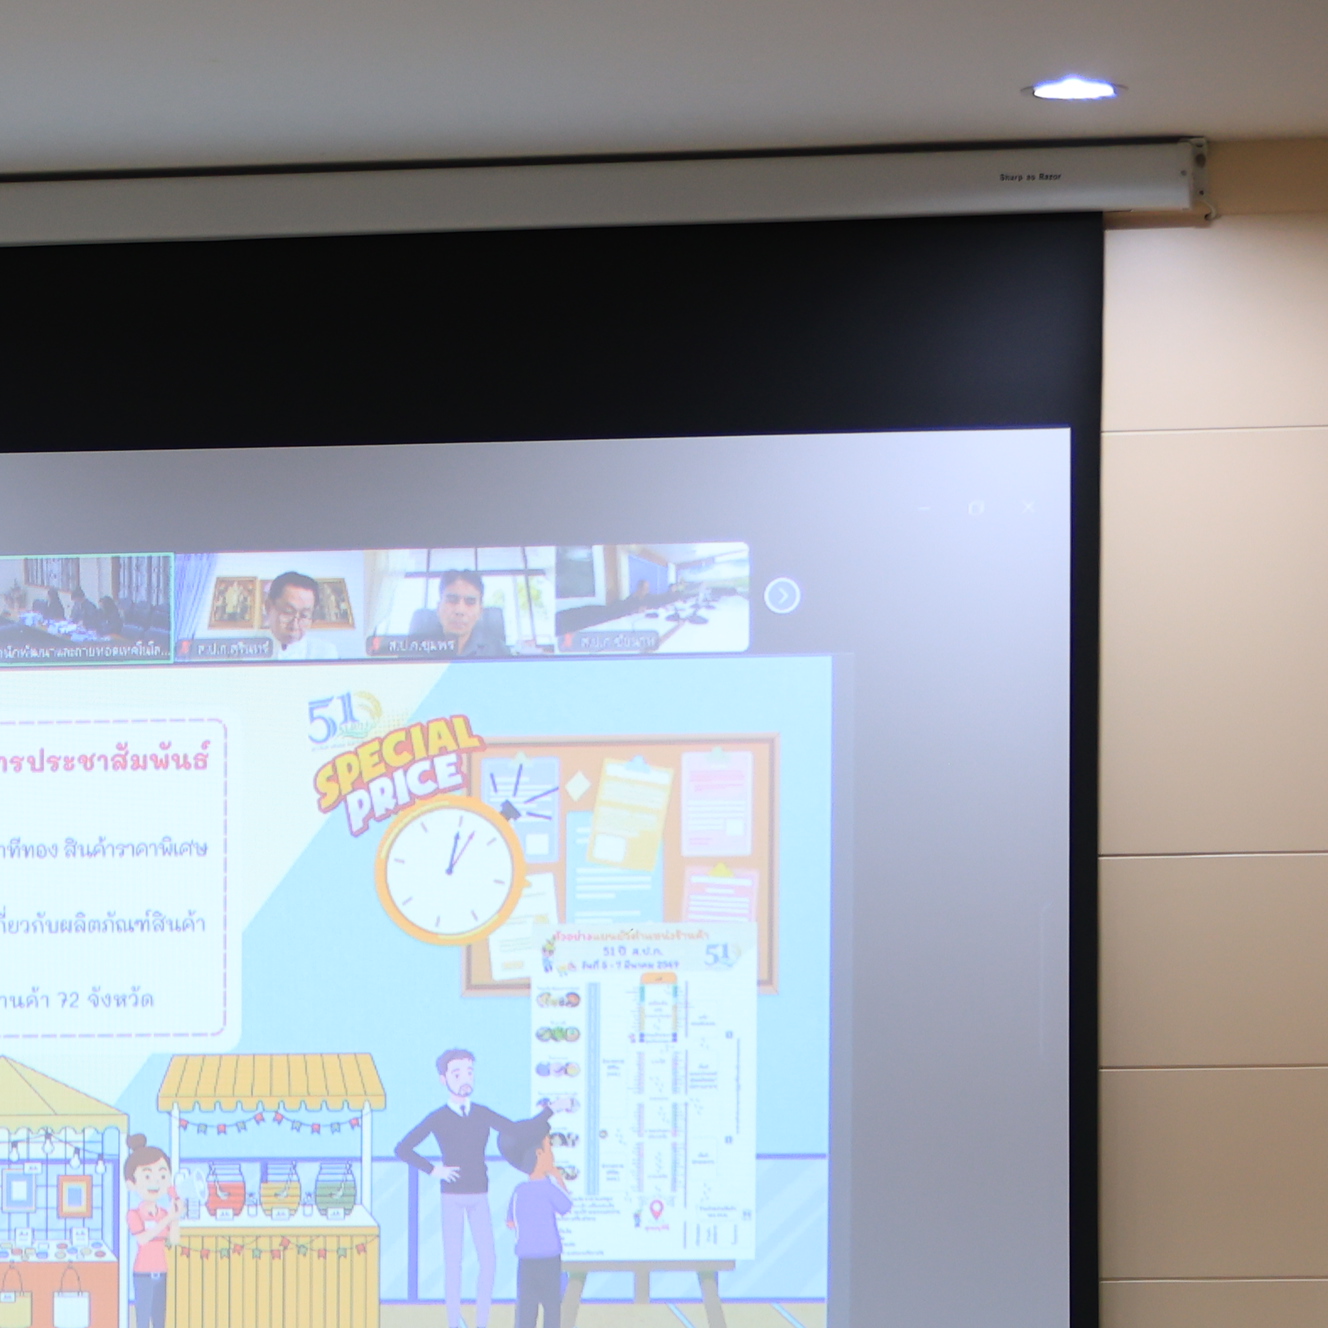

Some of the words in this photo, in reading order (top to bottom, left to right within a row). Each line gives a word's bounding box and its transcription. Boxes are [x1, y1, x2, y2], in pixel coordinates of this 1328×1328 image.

[314, 714, 486, 814] SPECIAL
[344, 752, 465, 838] PRICE
[63, 835, 209, 859] สินค้าราคาพิเศษ
[57, 991, 79, 1008] 72
[86, 985, 156, 1009] จังหวัด
